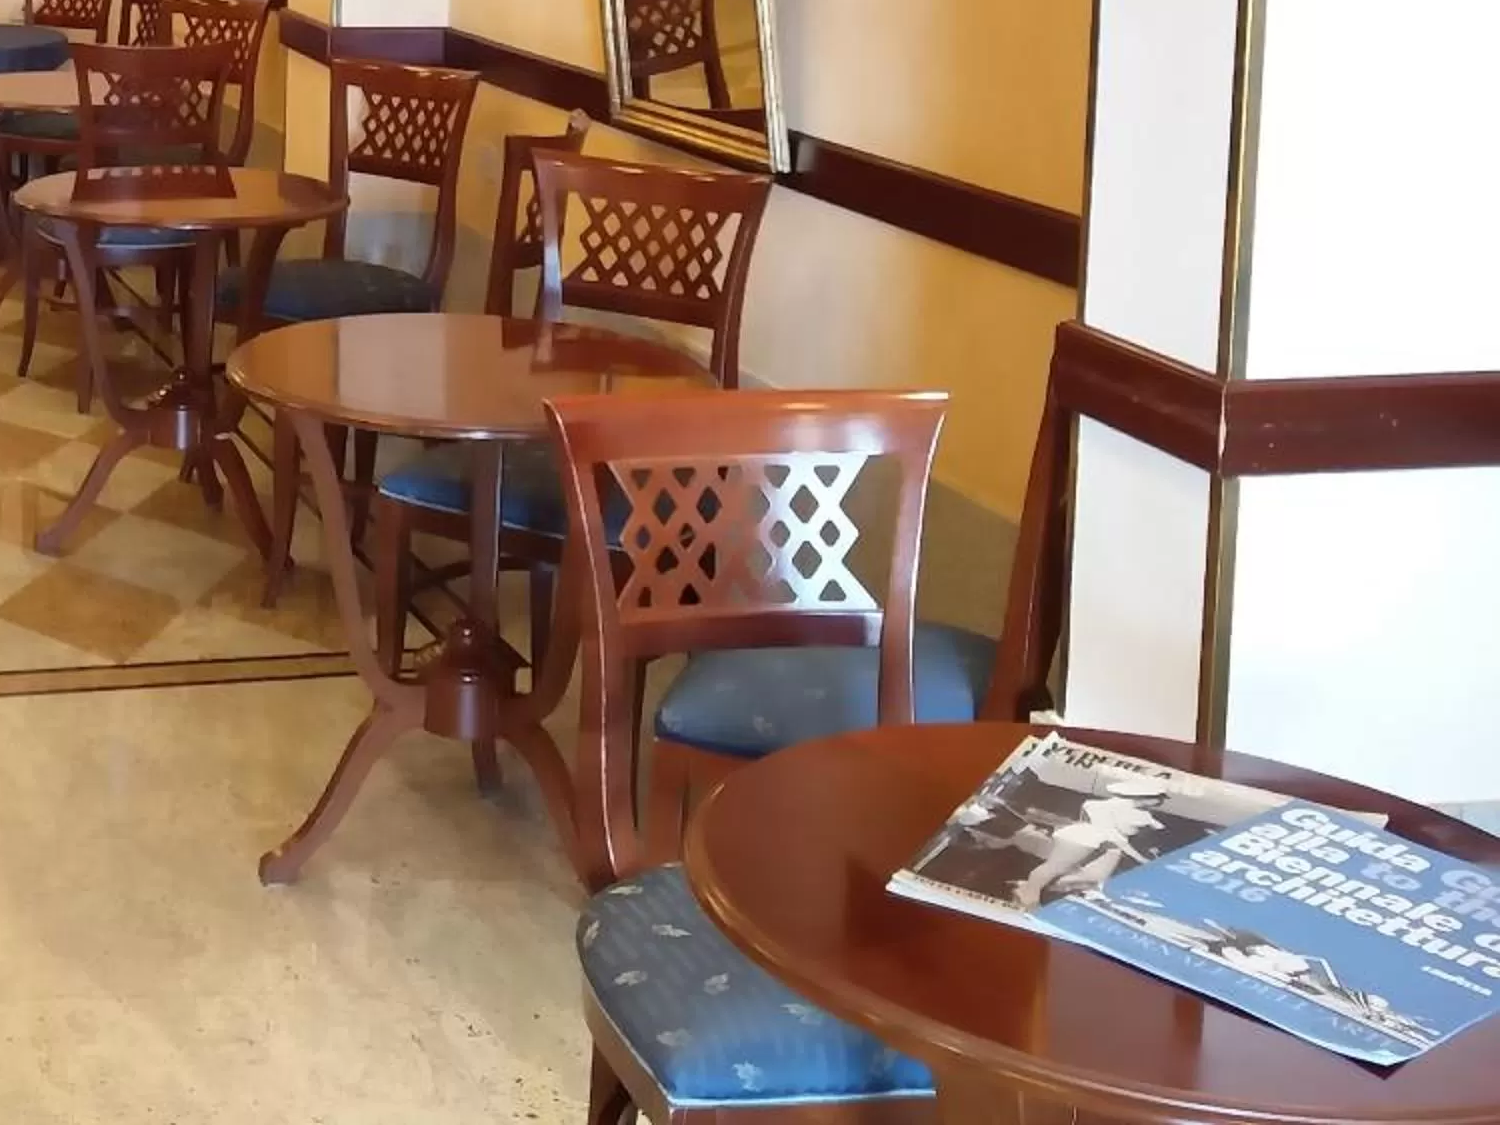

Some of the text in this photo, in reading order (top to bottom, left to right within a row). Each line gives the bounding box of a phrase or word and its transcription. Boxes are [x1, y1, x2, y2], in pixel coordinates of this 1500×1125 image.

[1249, 822, 1351, 865] alla
[1360, 860, 1423, 892] to
[1280, 807, 1432, 874] Guida
[1164, 858, 1273, 904] 2016
[1219, 828, 1464, 932] Biennale
